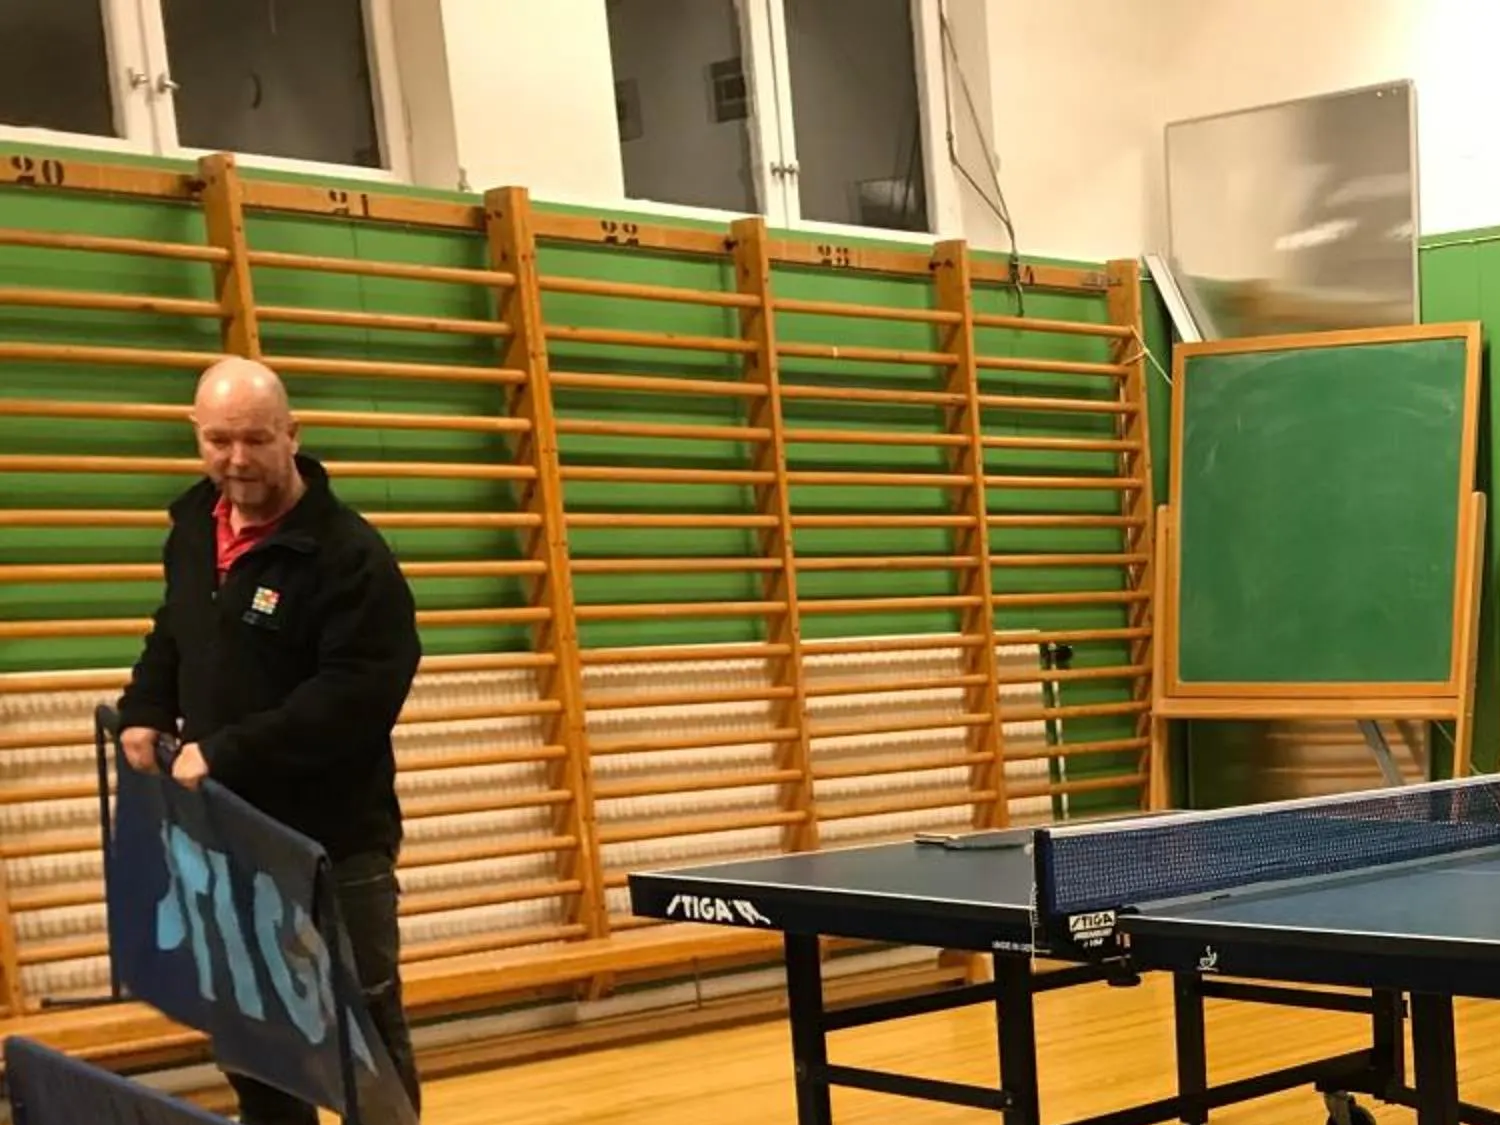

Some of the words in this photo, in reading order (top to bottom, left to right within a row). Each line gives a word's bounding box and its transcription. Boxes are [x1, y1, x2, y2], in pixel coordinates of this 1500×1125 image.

[10, 155, 65, 186] 20
[328, 189, 370, 218] 21
[666, 893, 735, 923] STIGA
[1071, 913, 1114, 929] STIGA
